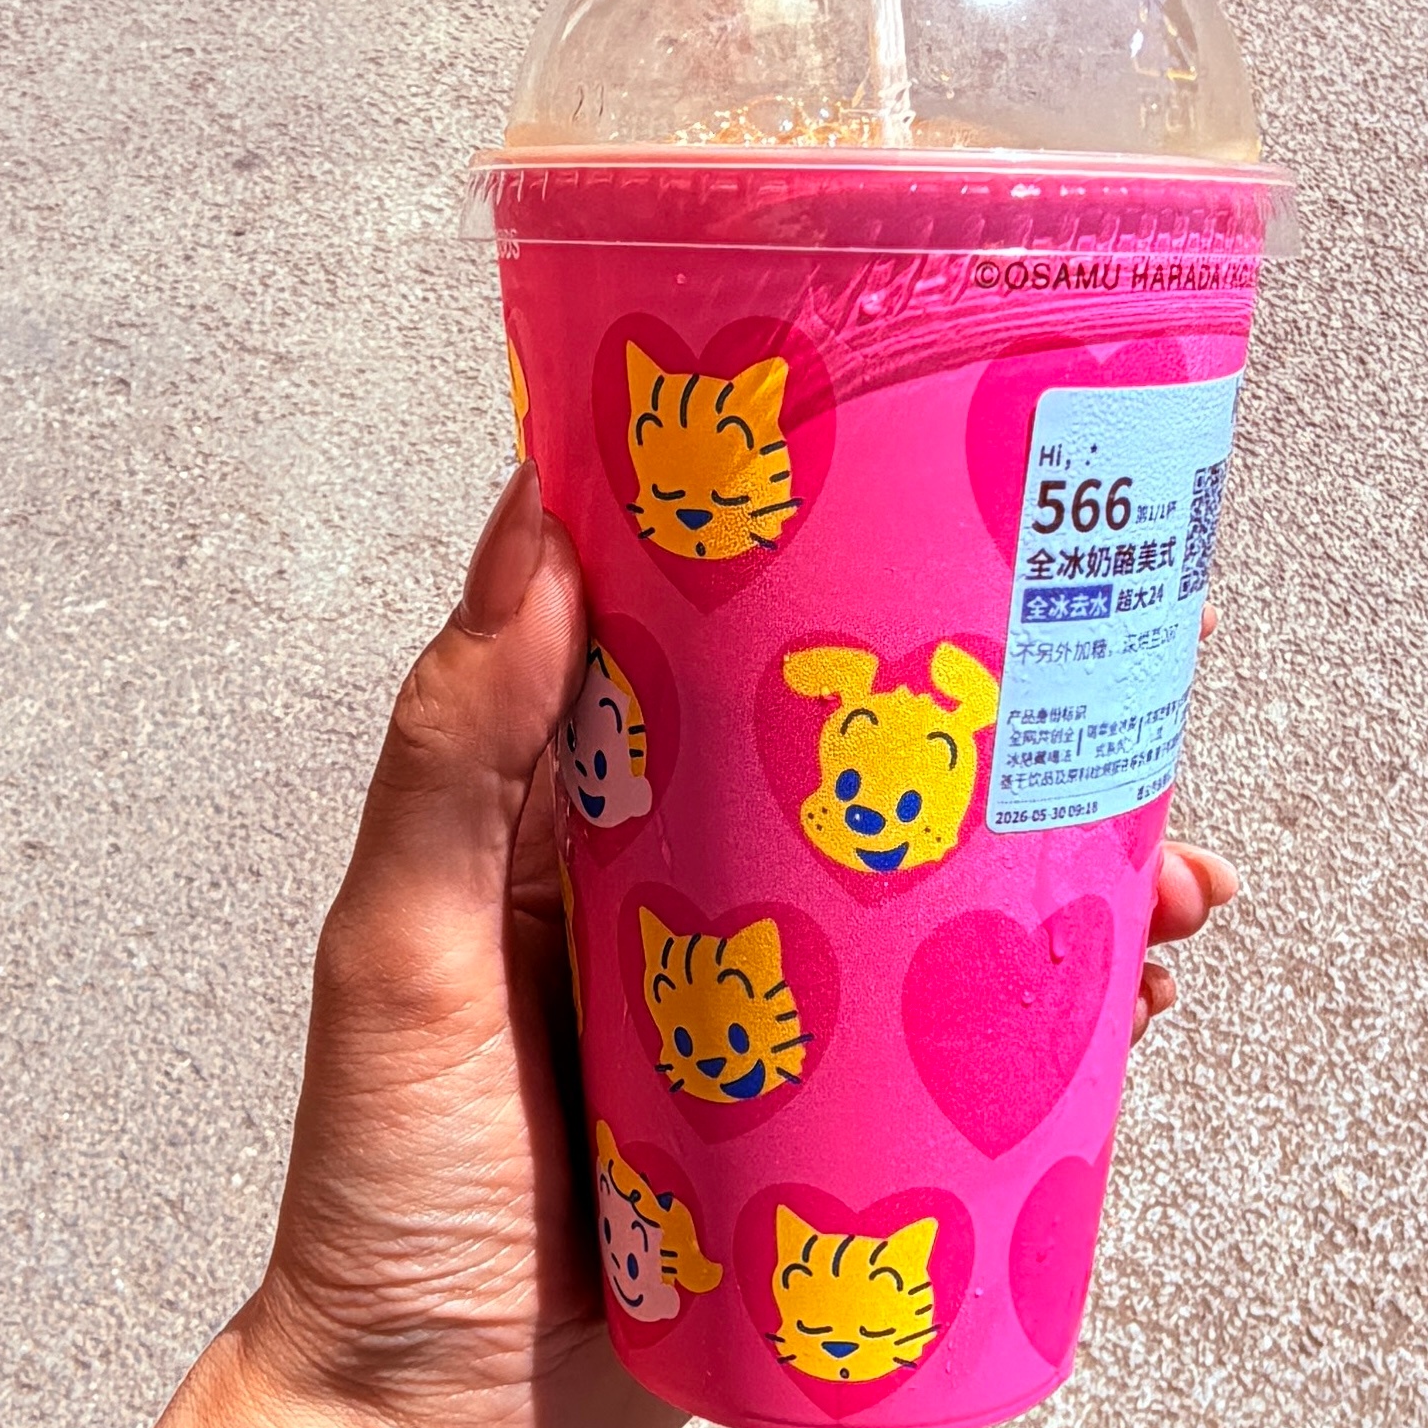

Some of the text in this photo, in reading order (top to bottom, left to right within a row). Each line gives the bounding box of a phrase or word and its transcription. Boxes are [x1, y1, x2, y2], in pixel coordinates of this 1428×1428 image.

[1032, 476, 1133, 534] 566
[1024, 536, 1176, 580] 全冰奶酪美式
[995, 806, 1066, 824] 2026-05-30
